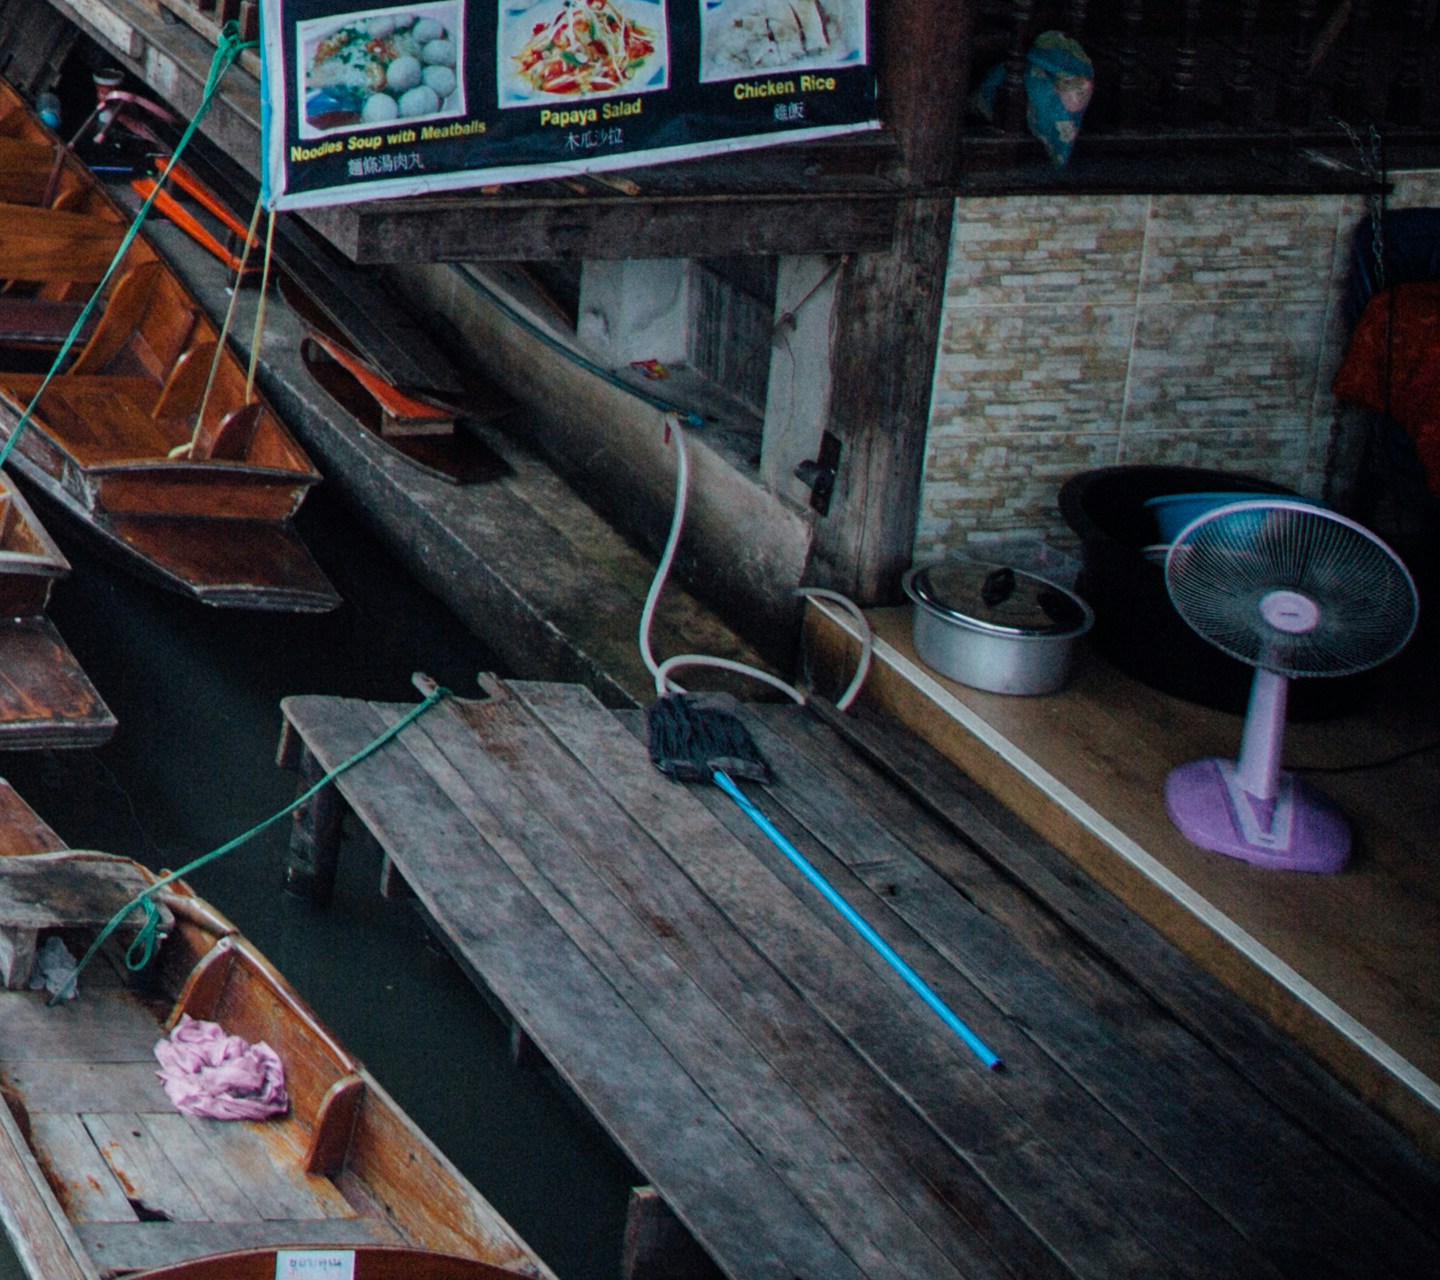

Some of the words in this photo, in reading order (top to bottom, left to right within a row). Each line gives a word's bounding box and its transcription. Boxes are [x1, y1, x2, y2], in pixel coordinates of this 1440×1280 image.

[733, 78, 796, 101] Chicken
[799, 73, 837, 92] Rice
[540, 105, 598, 128] Papaya
[602, 97, 643, 120] Salad
[290, 139, 345, 163] Noodles
[347, 134, 383, 152] Soup
[386, 128, 417, 146] with
[420, 119, 487, 141] Meatballs
